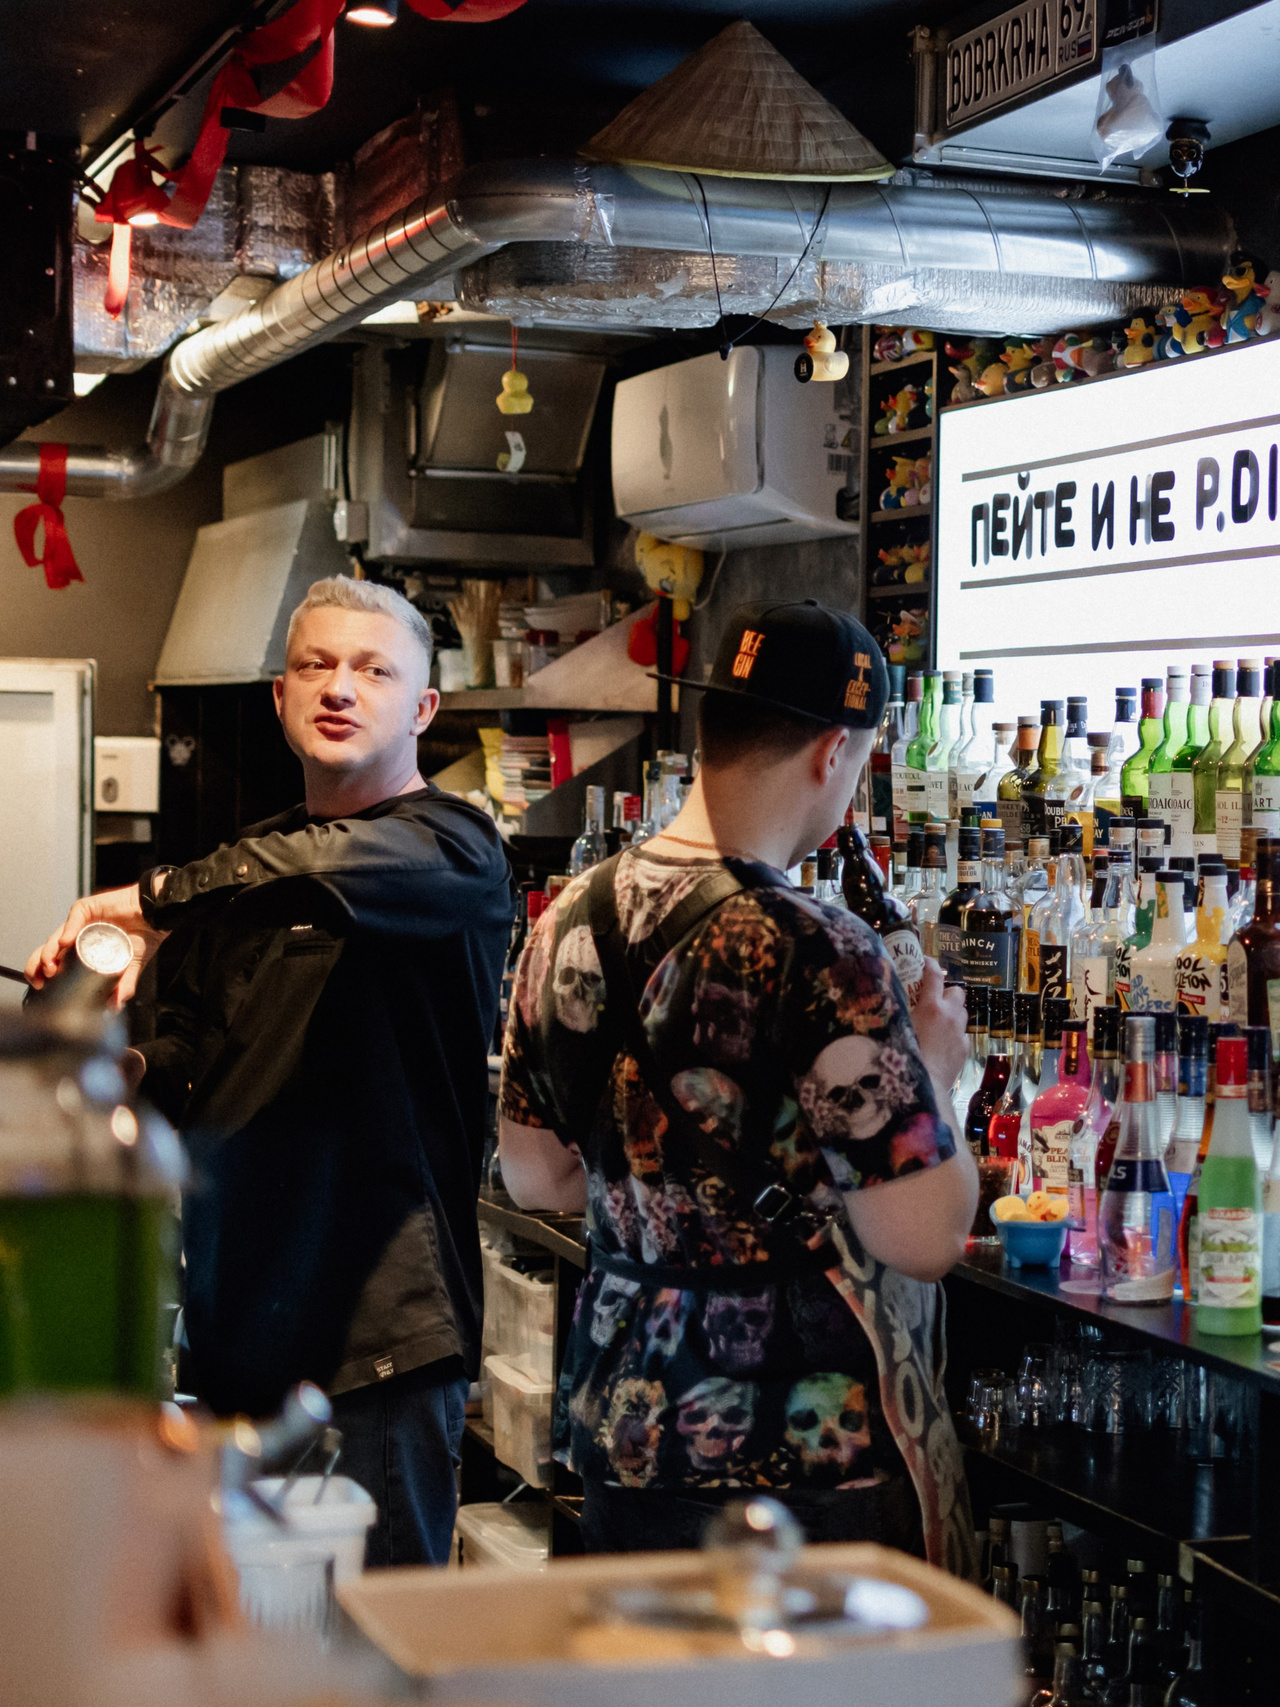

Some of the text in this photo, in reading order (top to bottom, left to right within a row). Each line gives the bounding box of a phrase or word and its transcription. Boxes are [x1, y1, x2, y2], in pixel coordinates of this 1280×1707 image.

[951, 2, 1051, 113] BOBRKRWA
[1058, 40, 1078, 64] RUS
[971, 470, 1077, 568] ПЕЙТЕ
[1091, 480, 1115, 551] И
[1129, 470, 1176, 546] НЕ
[732, 653, 755, 679] GIN
[939, 931, 951, 941] THE
[939, 942, 961, 952] STLE
